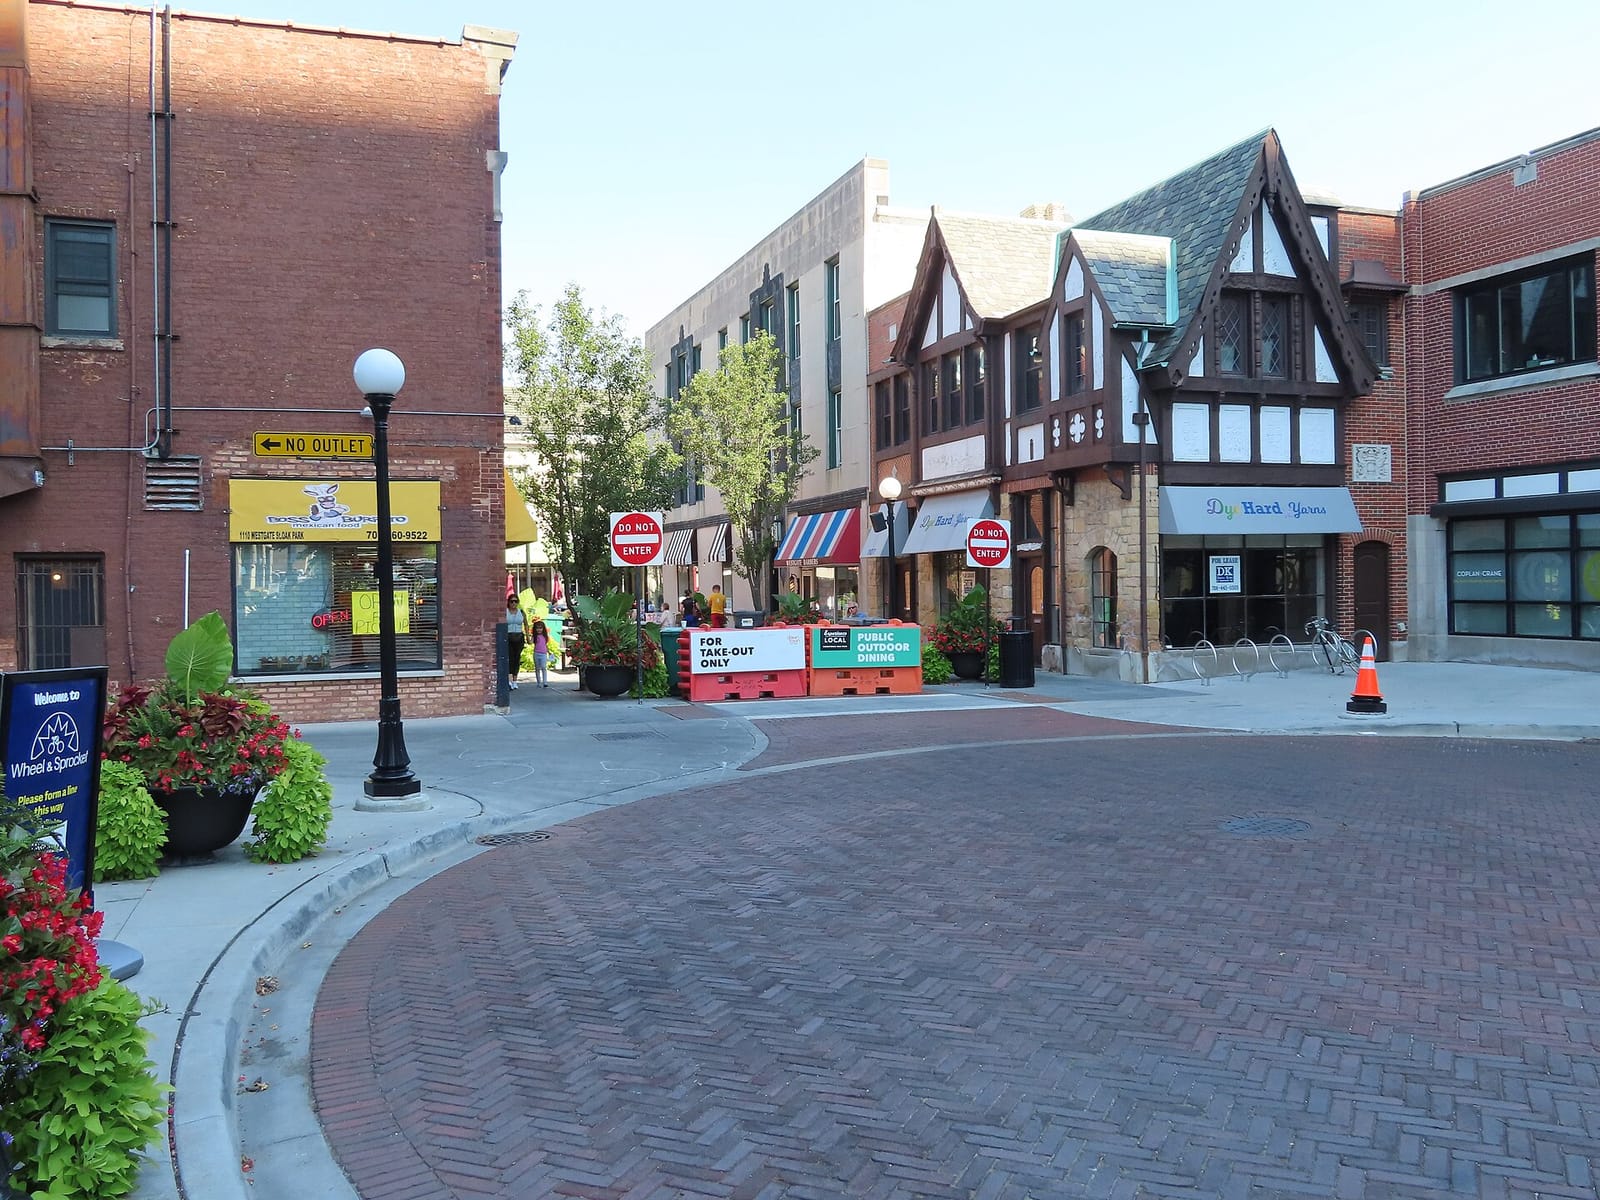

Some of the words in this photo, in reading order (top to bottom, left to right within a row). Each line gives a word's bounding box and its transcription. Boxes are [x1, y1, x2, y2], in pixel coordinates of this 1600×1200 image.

[286, 438, 305, 452] NO
[312, 438, 365, 453] OUTLET
[1206, 498, 1239, 520] Dye
[1241, 501, 1283, 515] Hard
[1288, 501, 1327, 519] Yarns
[341, 515, 407, 523] BURRTO
[935, 514, 954, 527] Hard
[618, 523, 631, 532] DO
[635, 523, 654, 532] NOT
[973, 528, 985, 537] DO
[987, 529, 1003, 537] NOT
[251, 531, 275, 540] WESTGATE
[292, 531, 305, 540] PARK
[366, 531, 428, 540] 7060-9522
[623, 546, 652, 556] ENTER
[976, 549, 1001, 558] ENTER
[1216, 566, 1233, 576] DK
[360, 593, 403, 610] OPN
[312, 608, 350, 628] OPEN
[700, 638, 722, 647] FOR
[857, 633, 894, 642] PUBLIC
[700, 647, 754, 657] TAKE-OUT
[857, 643, 910, 652] OUTDOOR
[857, 653, 895, 662] DINING
[700, 659, 730, 668] ONLY
[34, 691, 69, 706] Welcome
[69, 690, 80, 701] to
[11, 759, 45, 778] Wheel
[46, 761, 53, 772] &
[54, 750, 89, 773] Sprocket
[17, 793, 44, 806] Please
[44, 790, 62, 801] form
[62, 788, 67, 797] a
[67, 784, 79, 796] line
[34, 804, 49, 816] this
[50, 802, 65, 813] way
